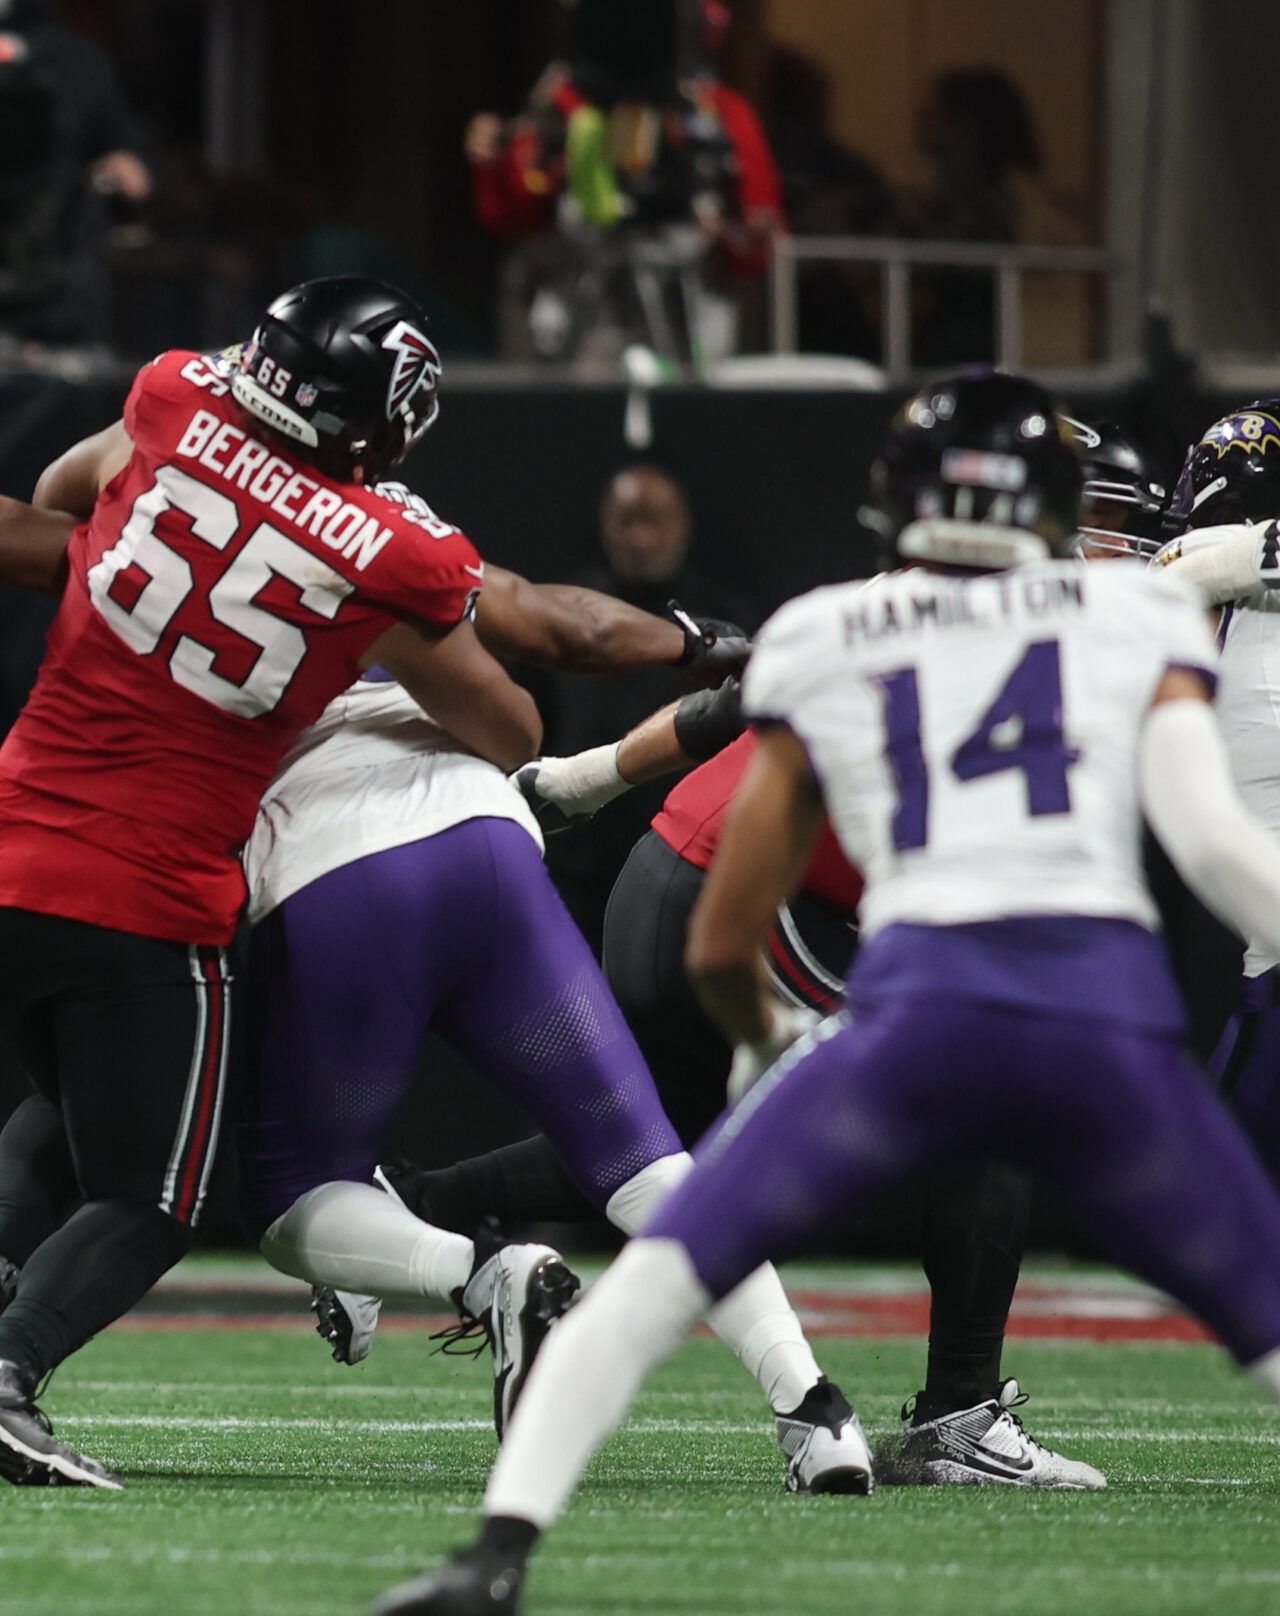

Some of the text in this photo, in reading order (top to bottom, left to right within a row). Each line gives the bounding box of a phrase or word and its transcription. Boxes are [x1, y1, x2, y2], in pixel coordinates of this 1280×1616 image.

[257, 357, 292, 397] 65
[176, 409, 394, 572] BERGERON
[87, 464, 356, 719] 65
[841, 577, 1085, 646] HAMILTON
[870, 637, 1082, 853] 14
